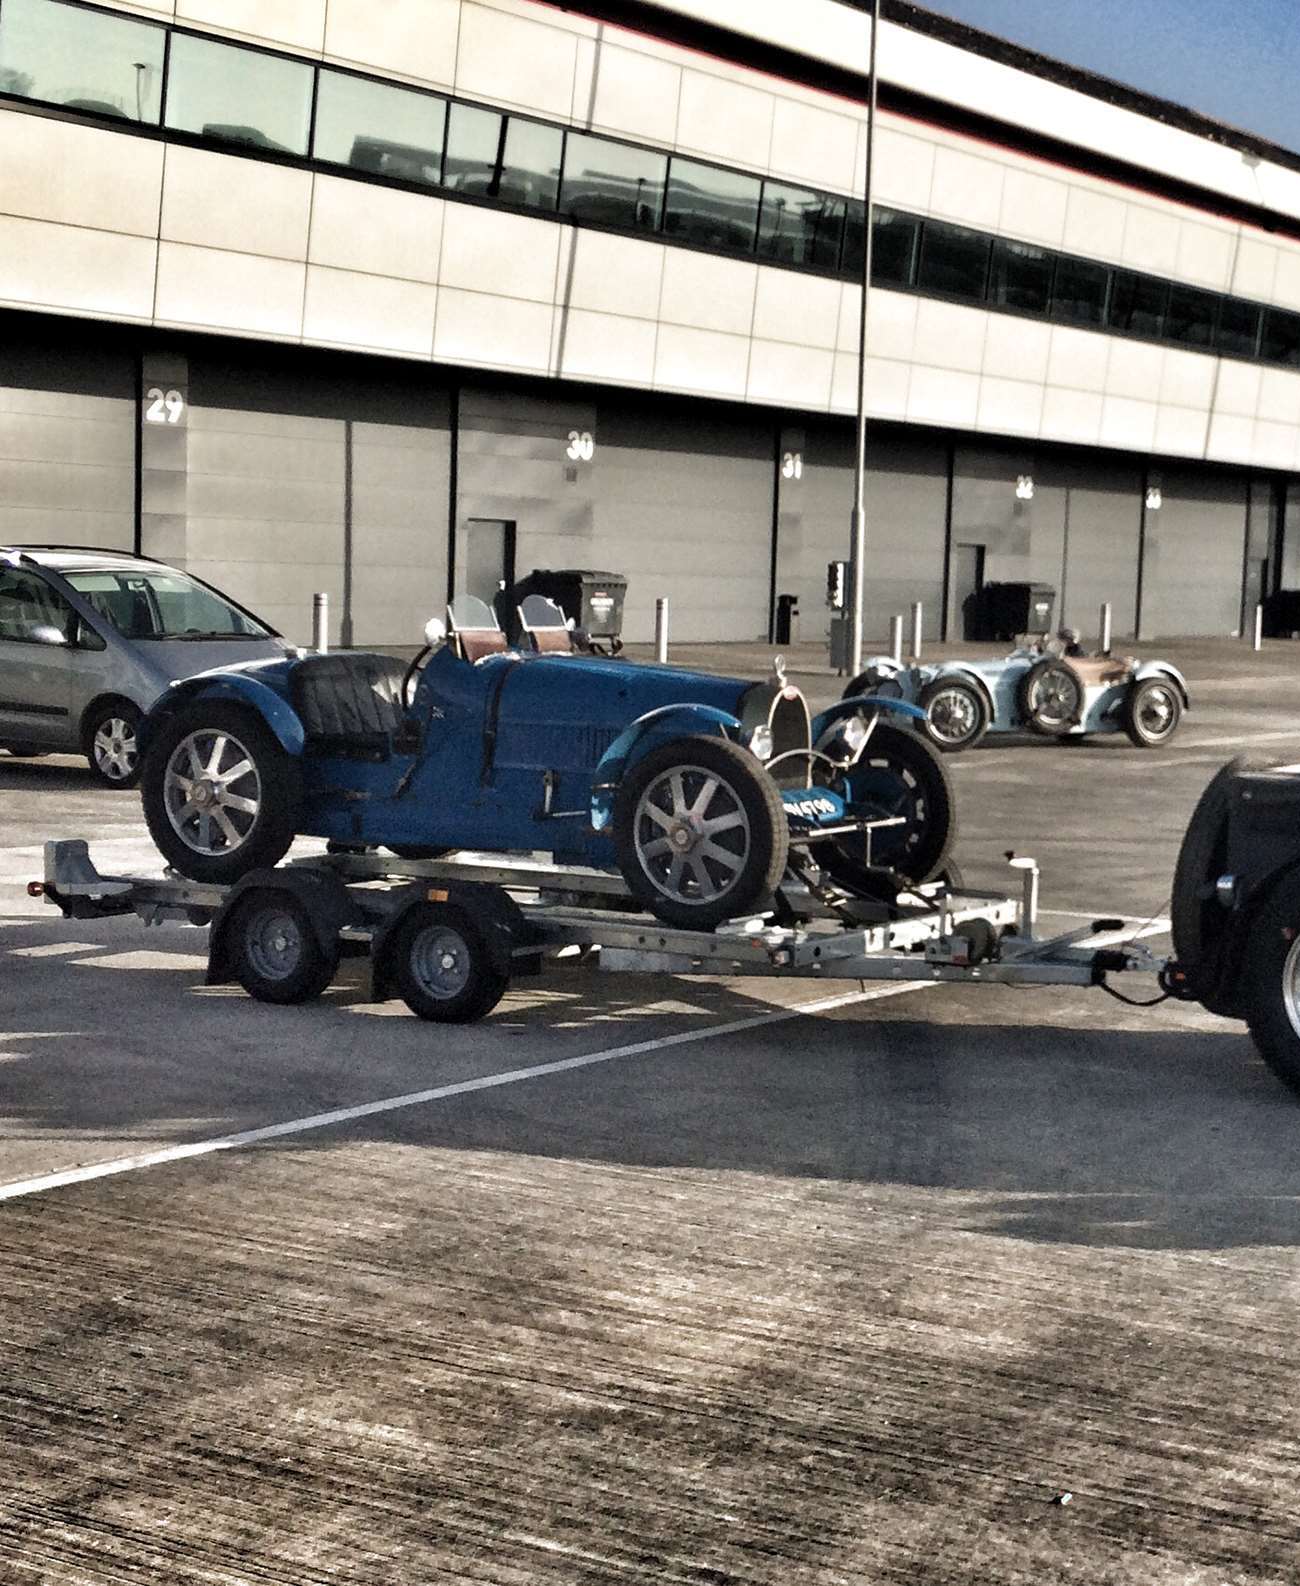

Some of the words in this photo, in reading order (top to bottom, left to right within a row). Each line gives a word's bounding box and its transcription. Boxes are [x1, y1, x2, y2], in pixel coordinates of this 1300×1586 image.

[146, 388, 183, 423] 29
[566, 431, 594, 461] 30
[782, 453, 802, 480] 31
